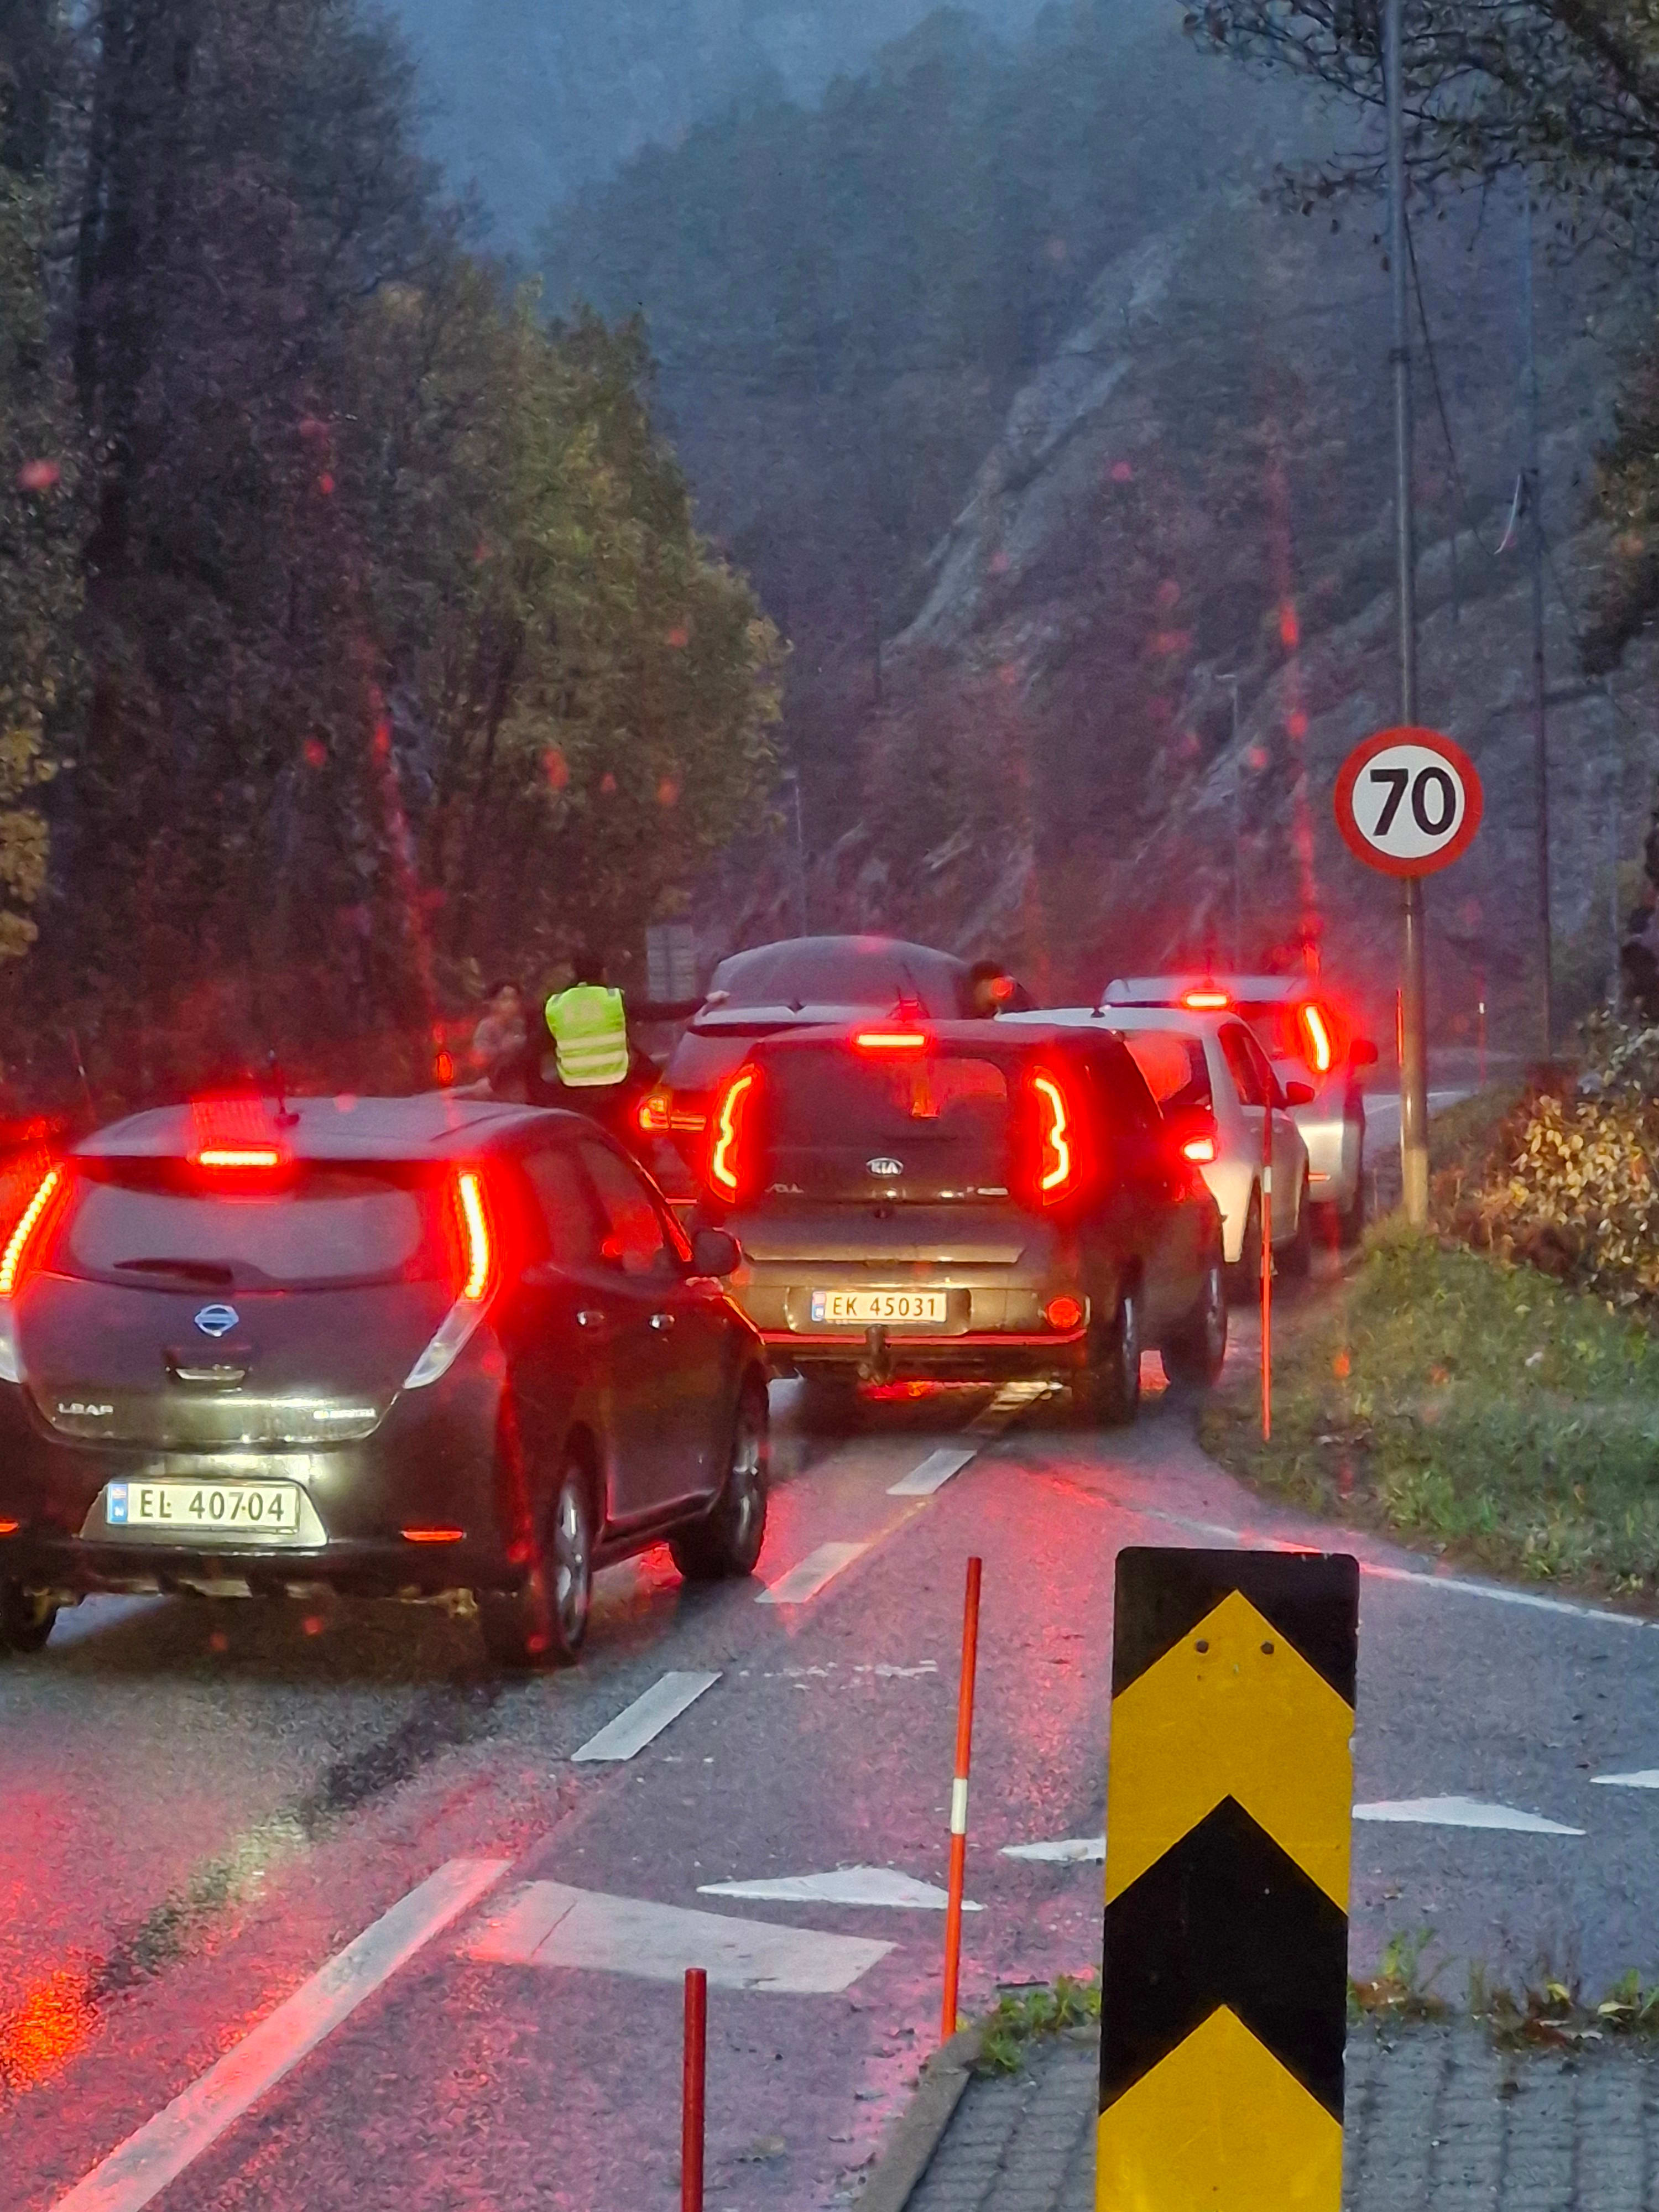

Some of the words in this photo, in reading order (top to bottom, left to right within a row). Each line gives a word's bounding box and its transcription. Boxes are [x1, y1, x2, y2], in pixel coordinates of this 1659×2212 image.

[1370, 766, 1456, 836] 70
[871, 1162, 899, 1173] KIA
[833, 1297, 857, 1316] EK
[870, 1297, 935, 1317] 45031
[140, 1489, 172, 1518] EL
[189, 1491, 284, 1522] 40704
